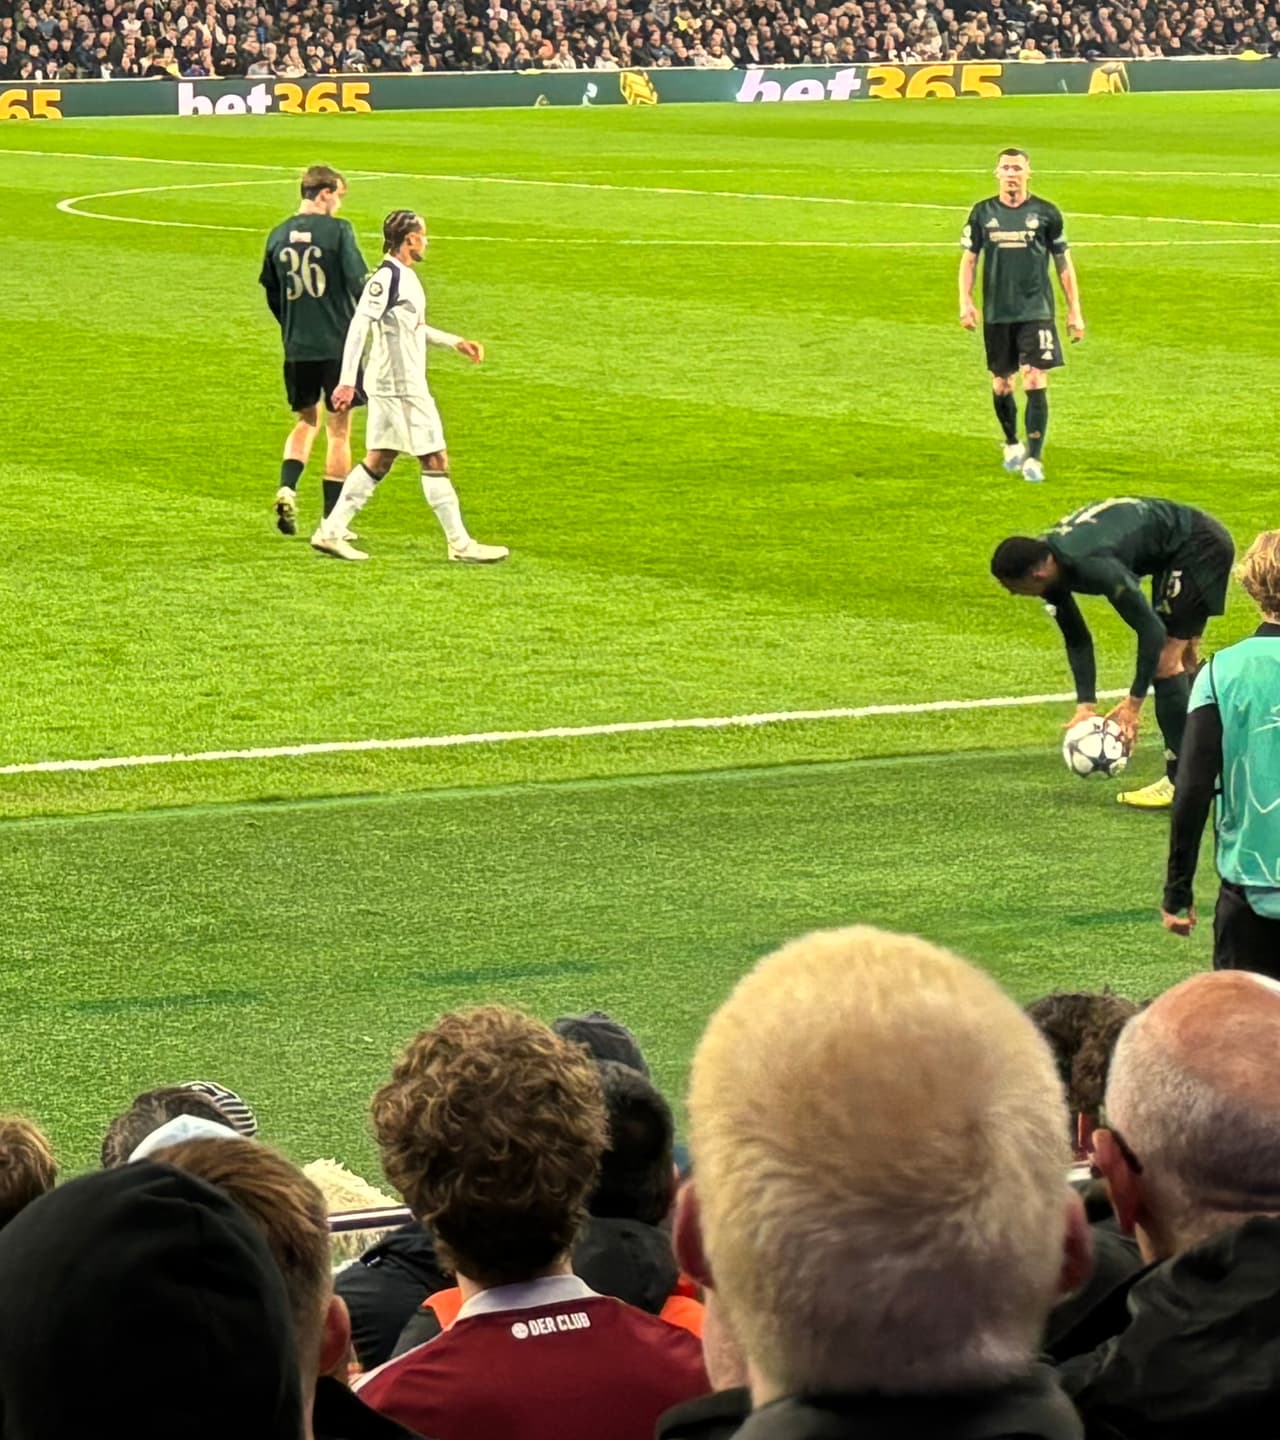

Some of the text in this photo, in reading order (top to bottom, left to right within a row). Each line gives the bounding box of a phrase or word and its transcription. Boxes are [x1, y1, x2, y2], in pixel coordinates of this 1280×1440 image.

[178, 82, 372, 116] bet365
[738, 64, 1002, 102] bet365
[279, 245, 327, 301] 36
[528, 1312, 591, 1337] DER CLUB
